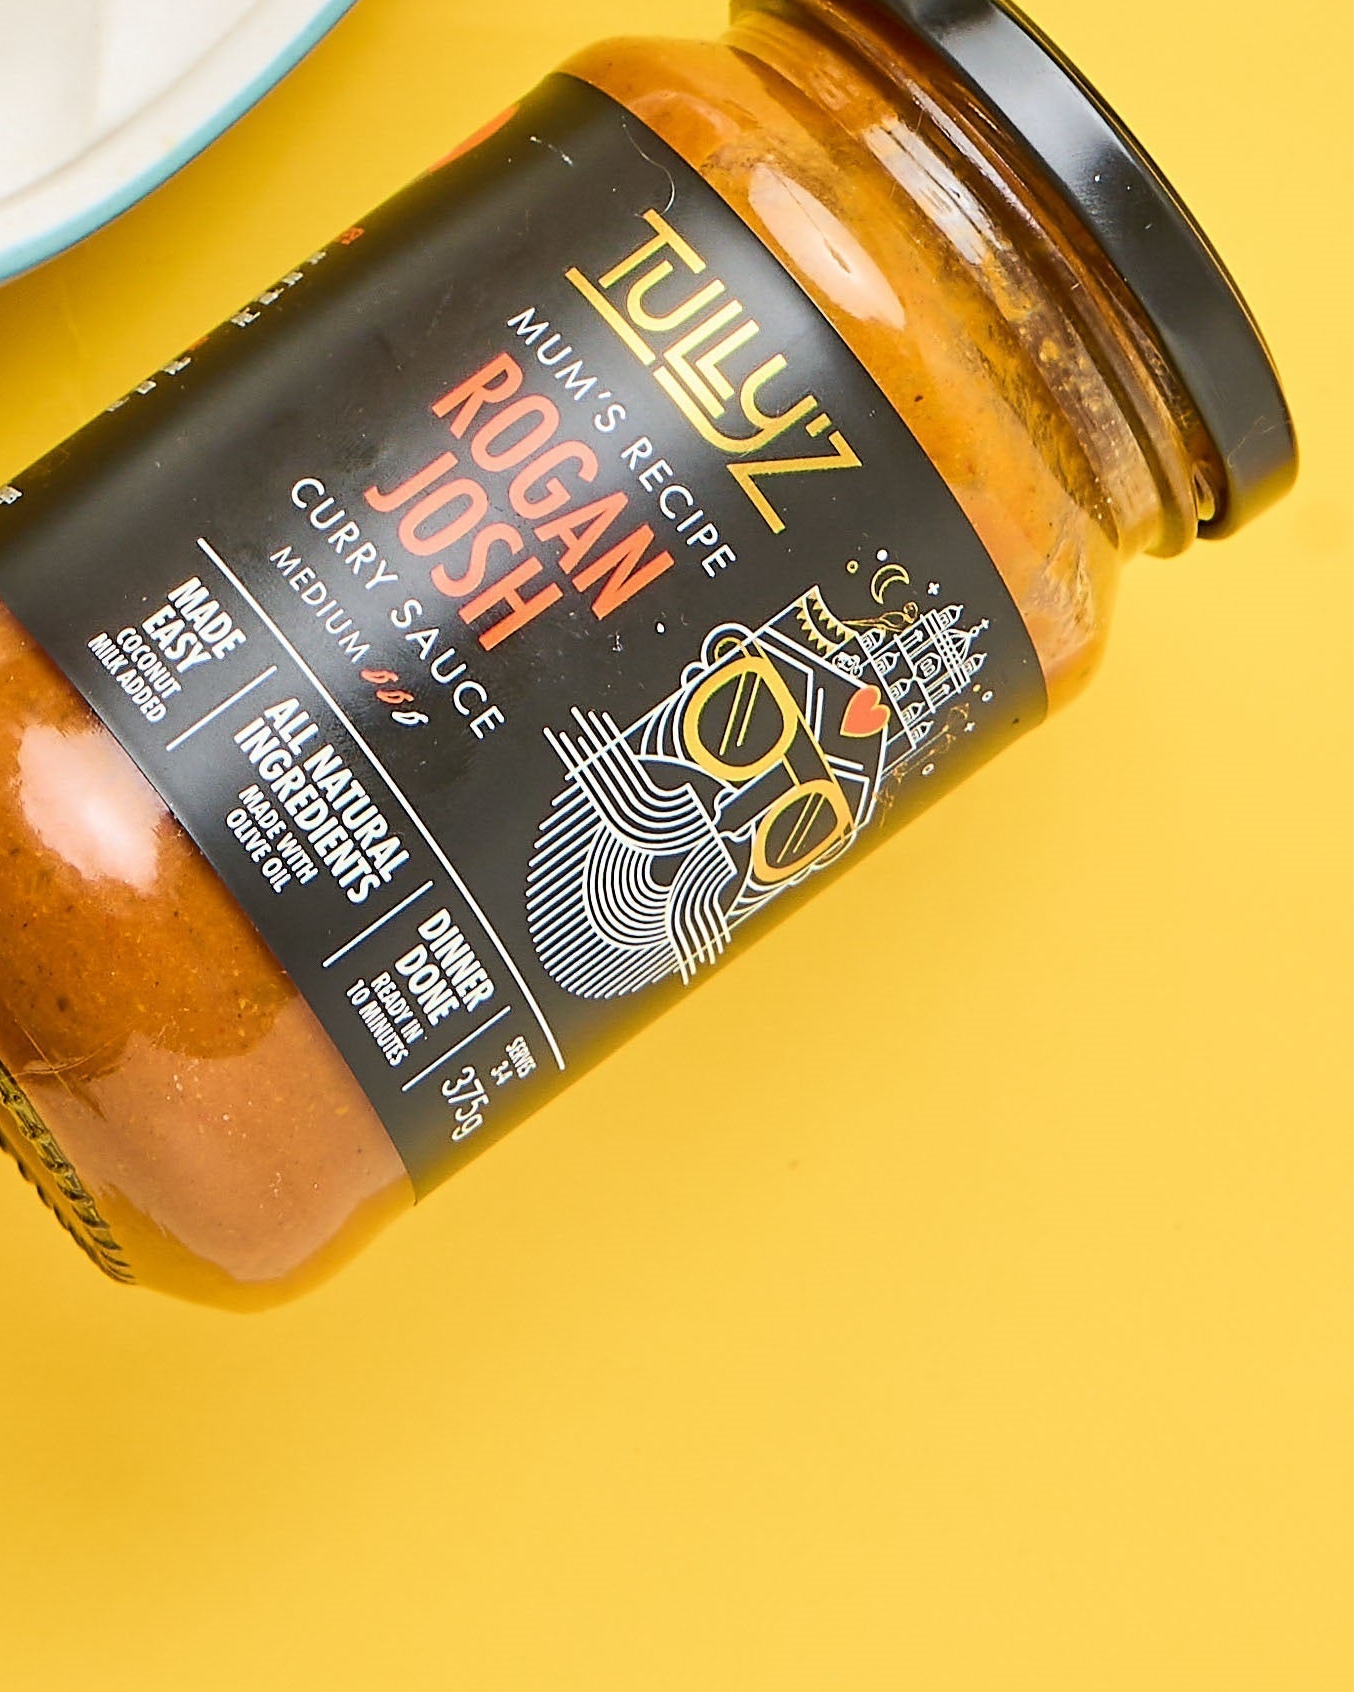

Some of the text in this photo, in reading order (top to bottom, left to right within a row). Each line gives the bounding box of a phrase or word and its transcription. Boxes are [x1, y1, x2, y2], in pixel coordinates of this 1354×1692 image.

[431, 352, 675, 621] ROGAN
[507, 307, 737, 578] MUM'S RECIPE
[363, 451, 563, 651] JOSH
[141, 604, 212, 674] EASY
[167, 576, 247, 660] MADE
[269, 546, 371, 664] MEDIUM
[291, 478, 505, 739] CURRY SAUCE
[87, 632, 167, 723] MILK ADDED
[116, 627, 182, 700] COCONUT
[233, 716, 381, 904] INGREDIENTS
[238, 784, 319, 885] MADE WITH
[263, 697, 410, 883] ALL NATURAL
[226, 808, 292, 893] OLIVE OIL
[394, 944, 460, 1026] DONE
[417, 908, 495, 1013] DINNER
[346, 979, 409, 1067] 10 MINUTES
[370, 971, 424, 1044] READY IN
[505, 1036, 537, 1078] SERVES
[441, 1066, 490, 1141] 375g
